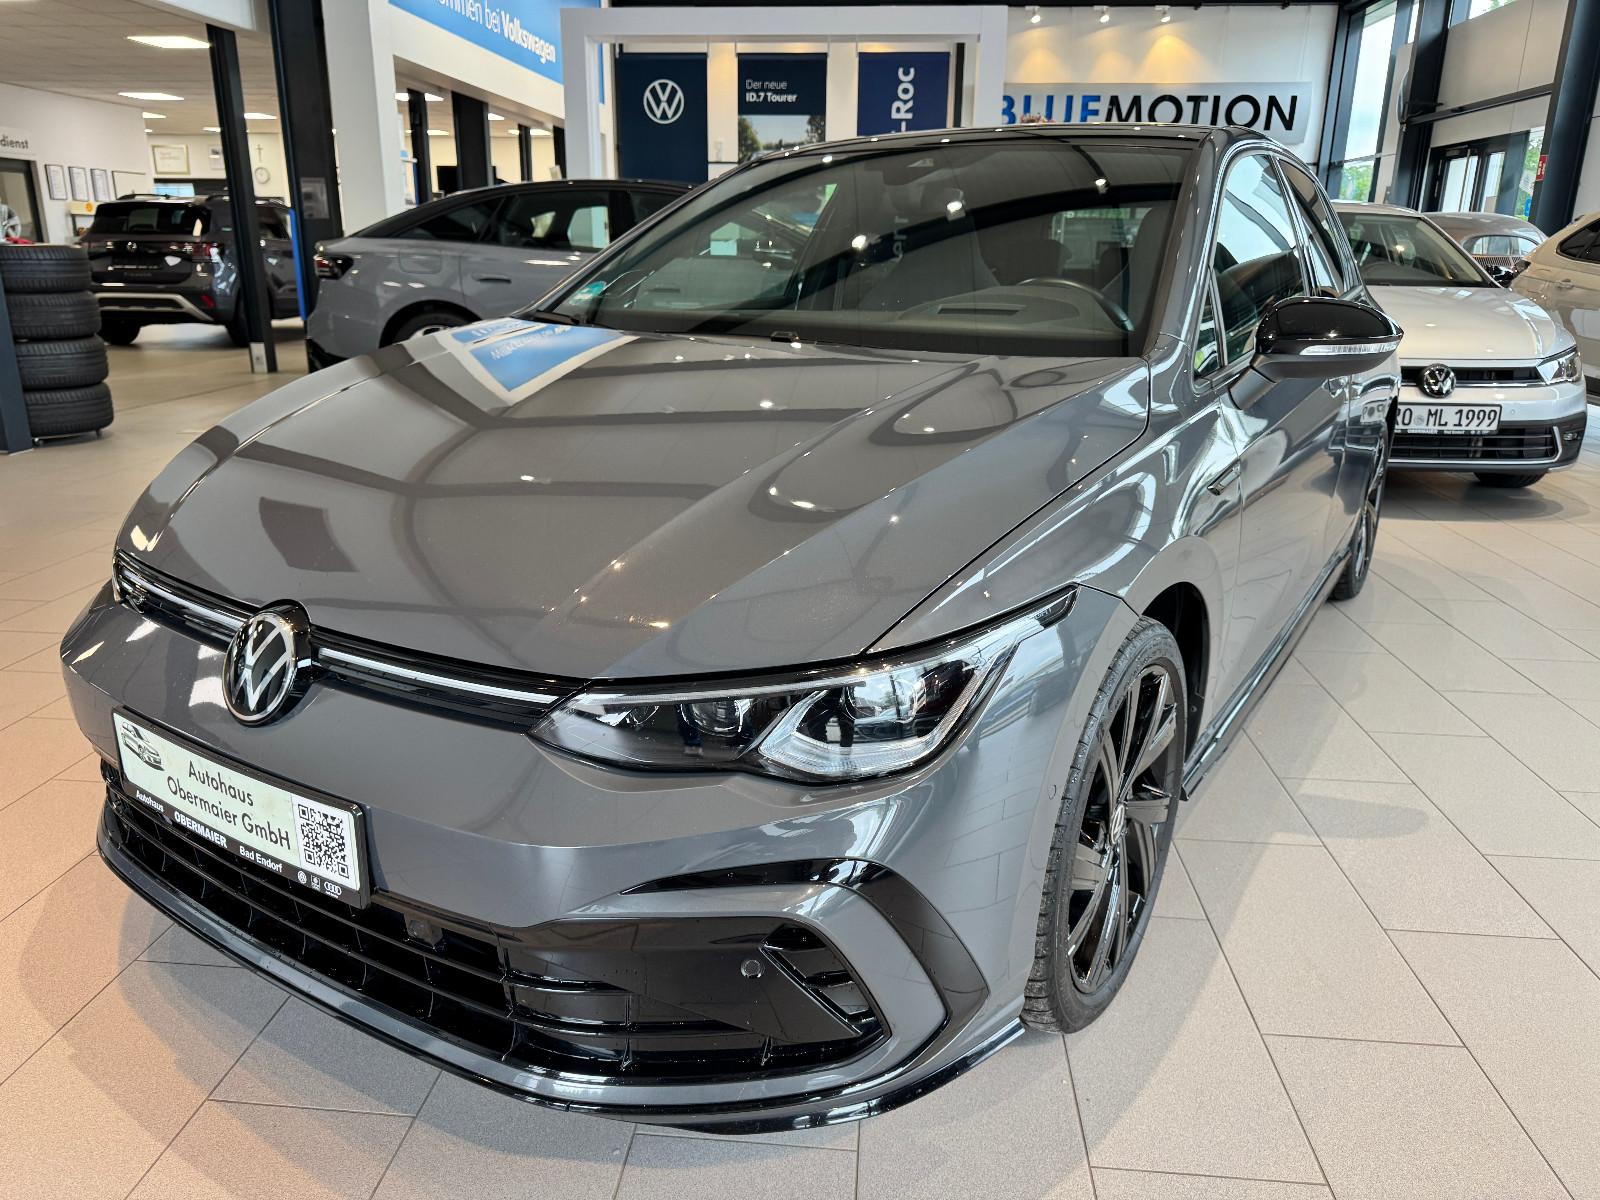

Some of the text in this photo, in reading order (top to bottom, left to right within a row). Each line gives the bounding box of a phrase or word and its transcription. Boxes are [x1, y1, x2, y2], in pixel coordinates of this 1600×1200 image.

[484, 1, 500, 33] bei
[501, 11, 556, 64] Volkswagen
[745, 79, 788, 90] Der neue
[745, 92, 798, 103] ID.7 Tourer
[891, 67, 915, 134] -Roc
[1426, 408, 1448, 427] ML
[1453, 408, 1498, 428] 1999
[188, 759, 254, 807] Autohaus
[136, 789, 283, 873] Autohaus OBERMAIER Bad Endorf
[166, 775, 291, 851] Obermaier GmbH
